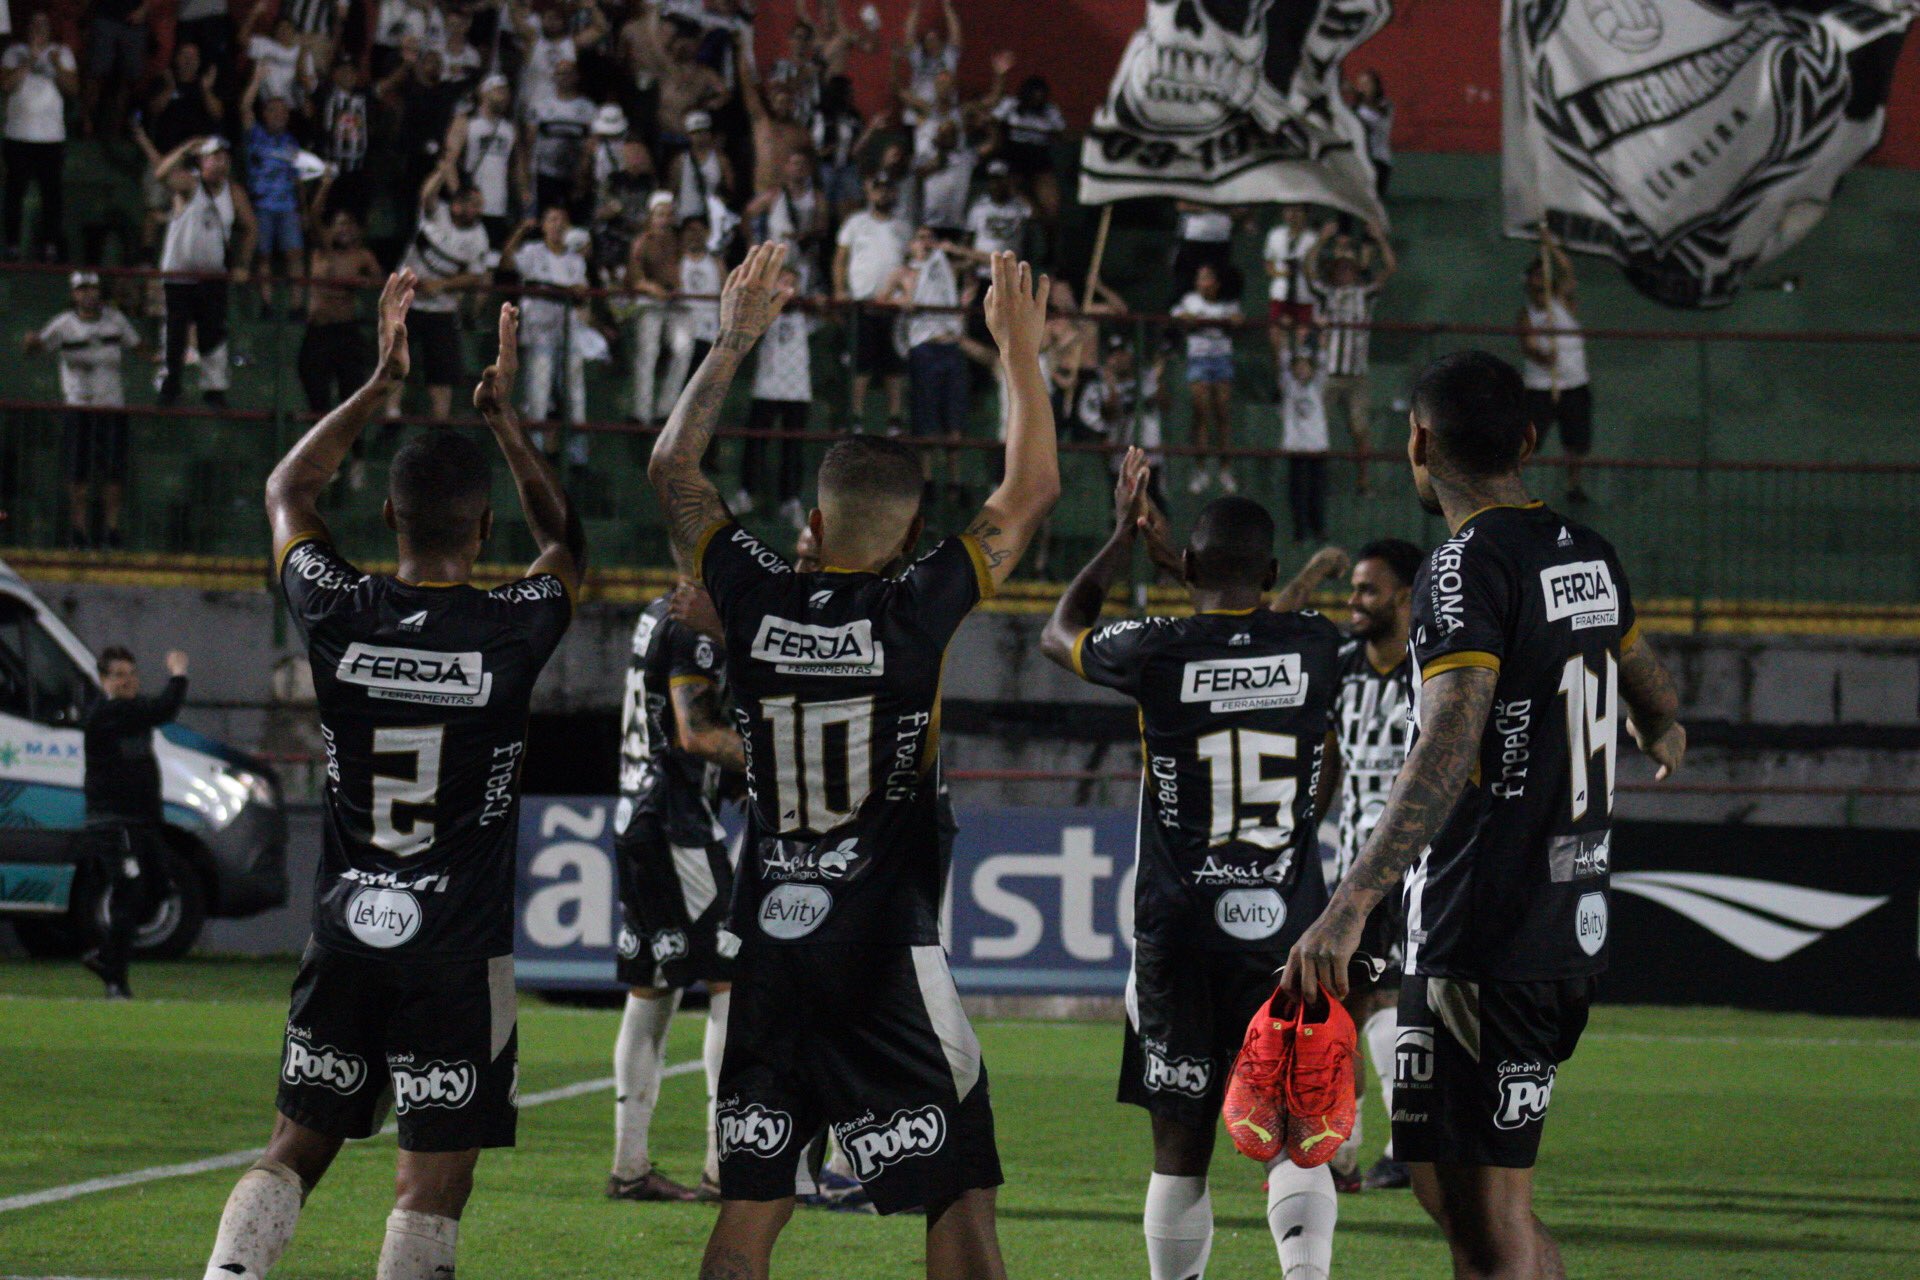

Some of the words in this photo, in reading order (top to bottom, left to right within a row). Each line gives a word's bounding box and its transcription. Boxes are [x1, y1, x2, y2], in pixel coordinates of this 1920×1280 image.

[1438, 543, 1464, 633] KRONA
[1550, 565, 1610, 608] FERJÁ
[764, 627, 862, 660] FERJÁ
[350, 656, 469, 686] FERJÁ
[788, 664, 872, 675] FERRAMENTAS
[1193, 658, 1292, 694] FERJÁ
[380, 690, 475, 705] FERRAMENTAS
[1221, 697, 1296, 711] FERRAMENTAS
[1557, 648, 1618, 822] 14
[758, 694, 875, 834] 10
[370, 724, 446, 857] 2
[1197, 728, 1298, 849] 15
[1192, 856, 1263, 884] Açaí
[288, 1041, 359, 1089] Poty
[1148, 1053, 1210, 1092] Poty
[393, 1066, 469, 1108] Poty
[721, 1112, 786, 1153] Poty
[851, 1112, 939, 1176] Poty
